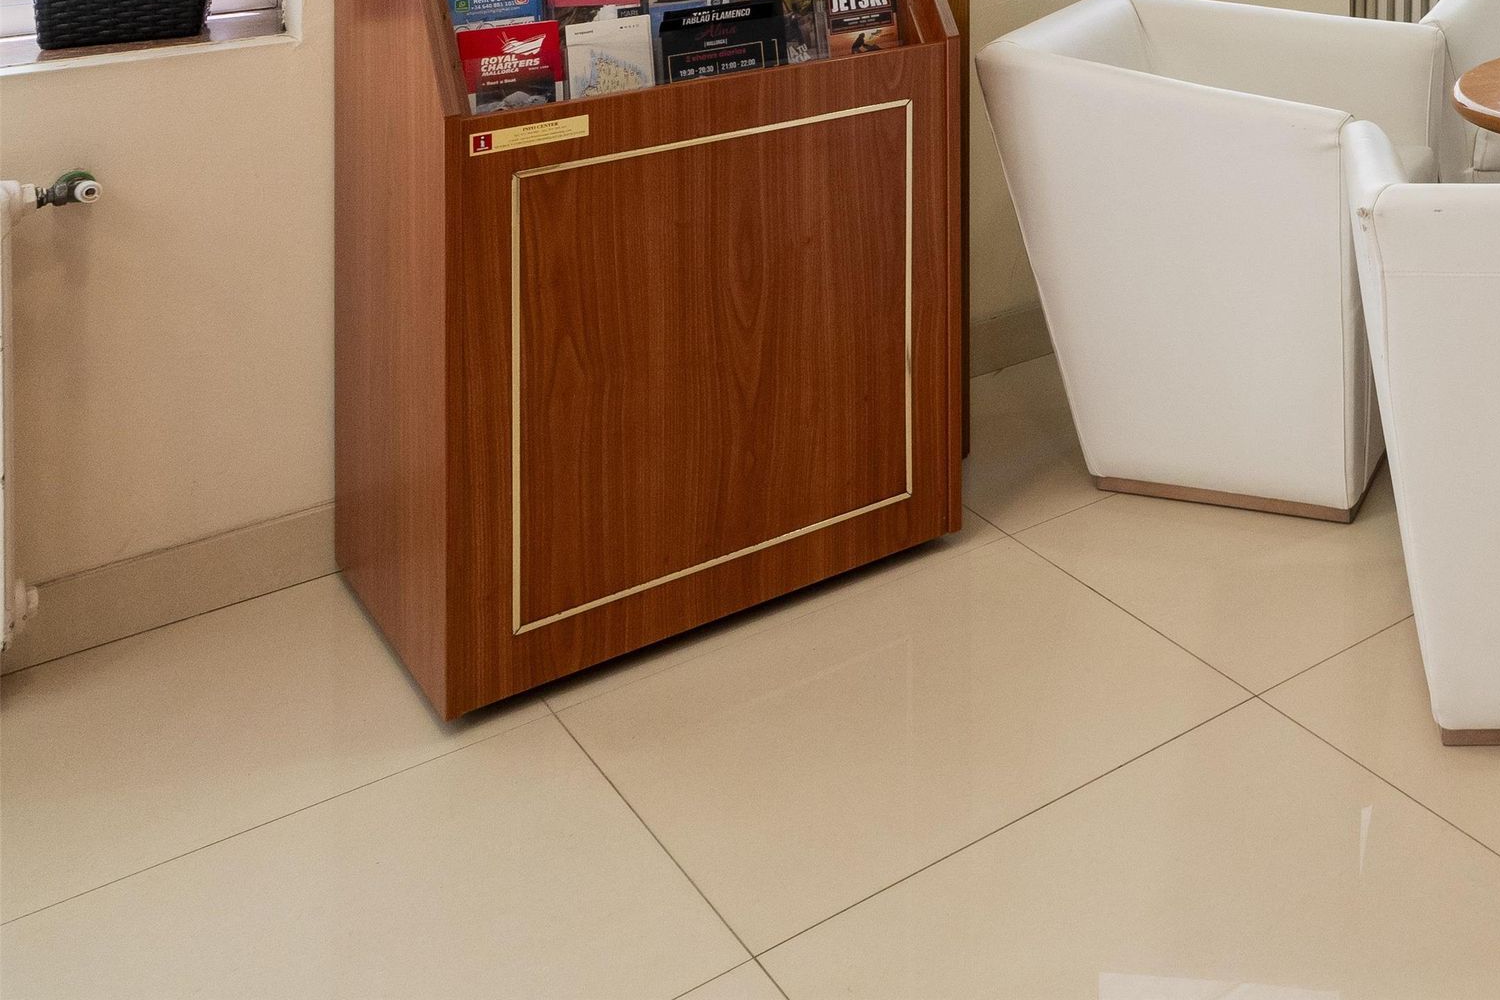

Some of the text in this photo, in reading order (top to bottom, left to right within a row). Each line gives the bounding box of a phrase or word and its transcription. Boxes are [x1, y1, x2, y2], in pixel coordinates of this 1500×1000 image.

[682, 13, 710, 26] TABLAO
[712, 7, 751, 21] FLAMENCO
[480, 56, 518, 66] ROYAL
[480, 58, 541, 72] CHARTERS
[481, 69, 519, 77] MALLORCA
[536, 122, 558, 130] CENTER
